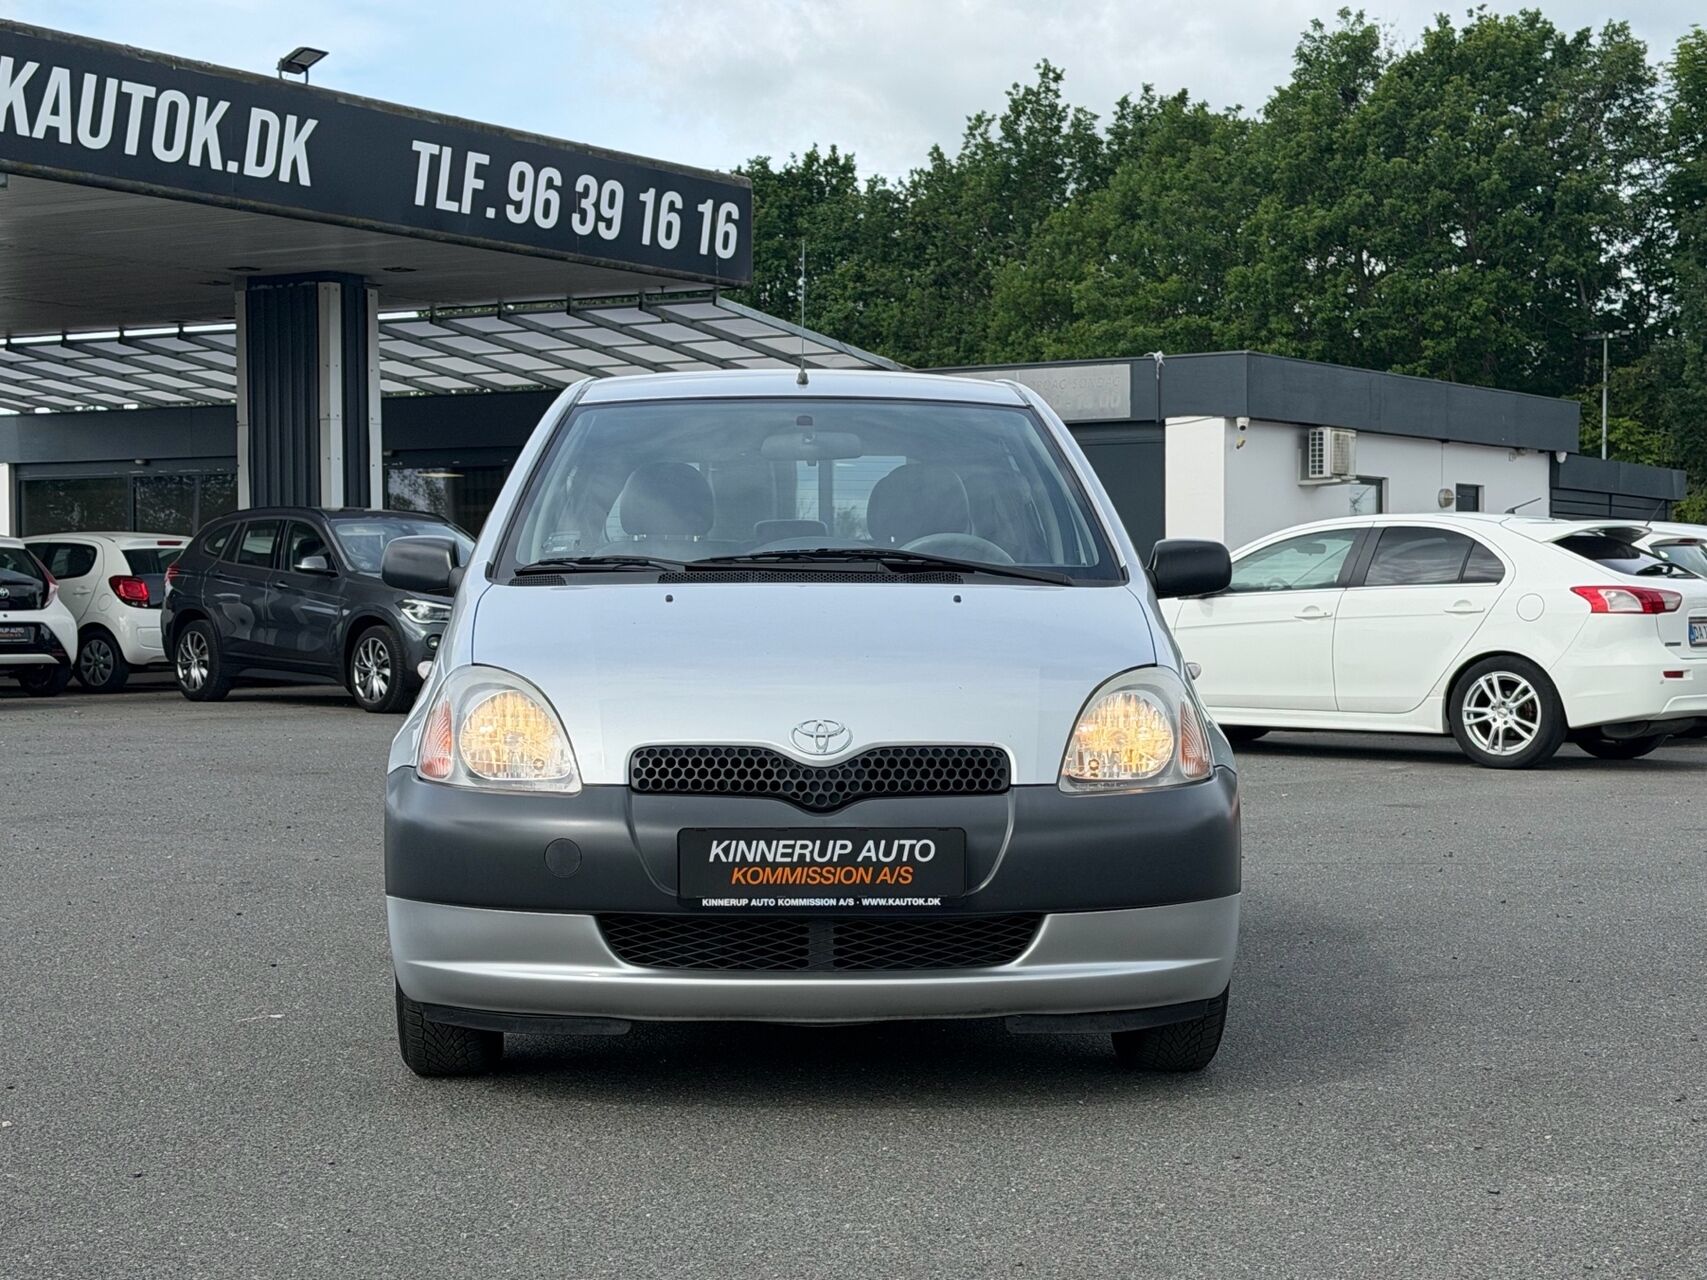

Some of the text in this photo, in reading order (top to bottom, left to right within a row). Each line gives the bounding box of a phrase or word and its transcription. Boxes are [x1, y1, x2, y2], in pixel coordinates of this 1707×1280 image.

[0, 55, 319, 187] KAUTOK.DK
[412, 140, 740, 259] TLF. 96 39 16 16
[708, 839, 936, 862] KINNERUP AUTO
[731, 866, 913, 885] KOMMISSION A/S
[702, 898, 749, 906] KINNERUP
[750, 898, 776, 906] AUTO
[777, 898, 837, 906] KOMMISSION
[838, 898, 854, 906] A/S
[861, 897, 941, 906] WWW.KAUTOK.DK
